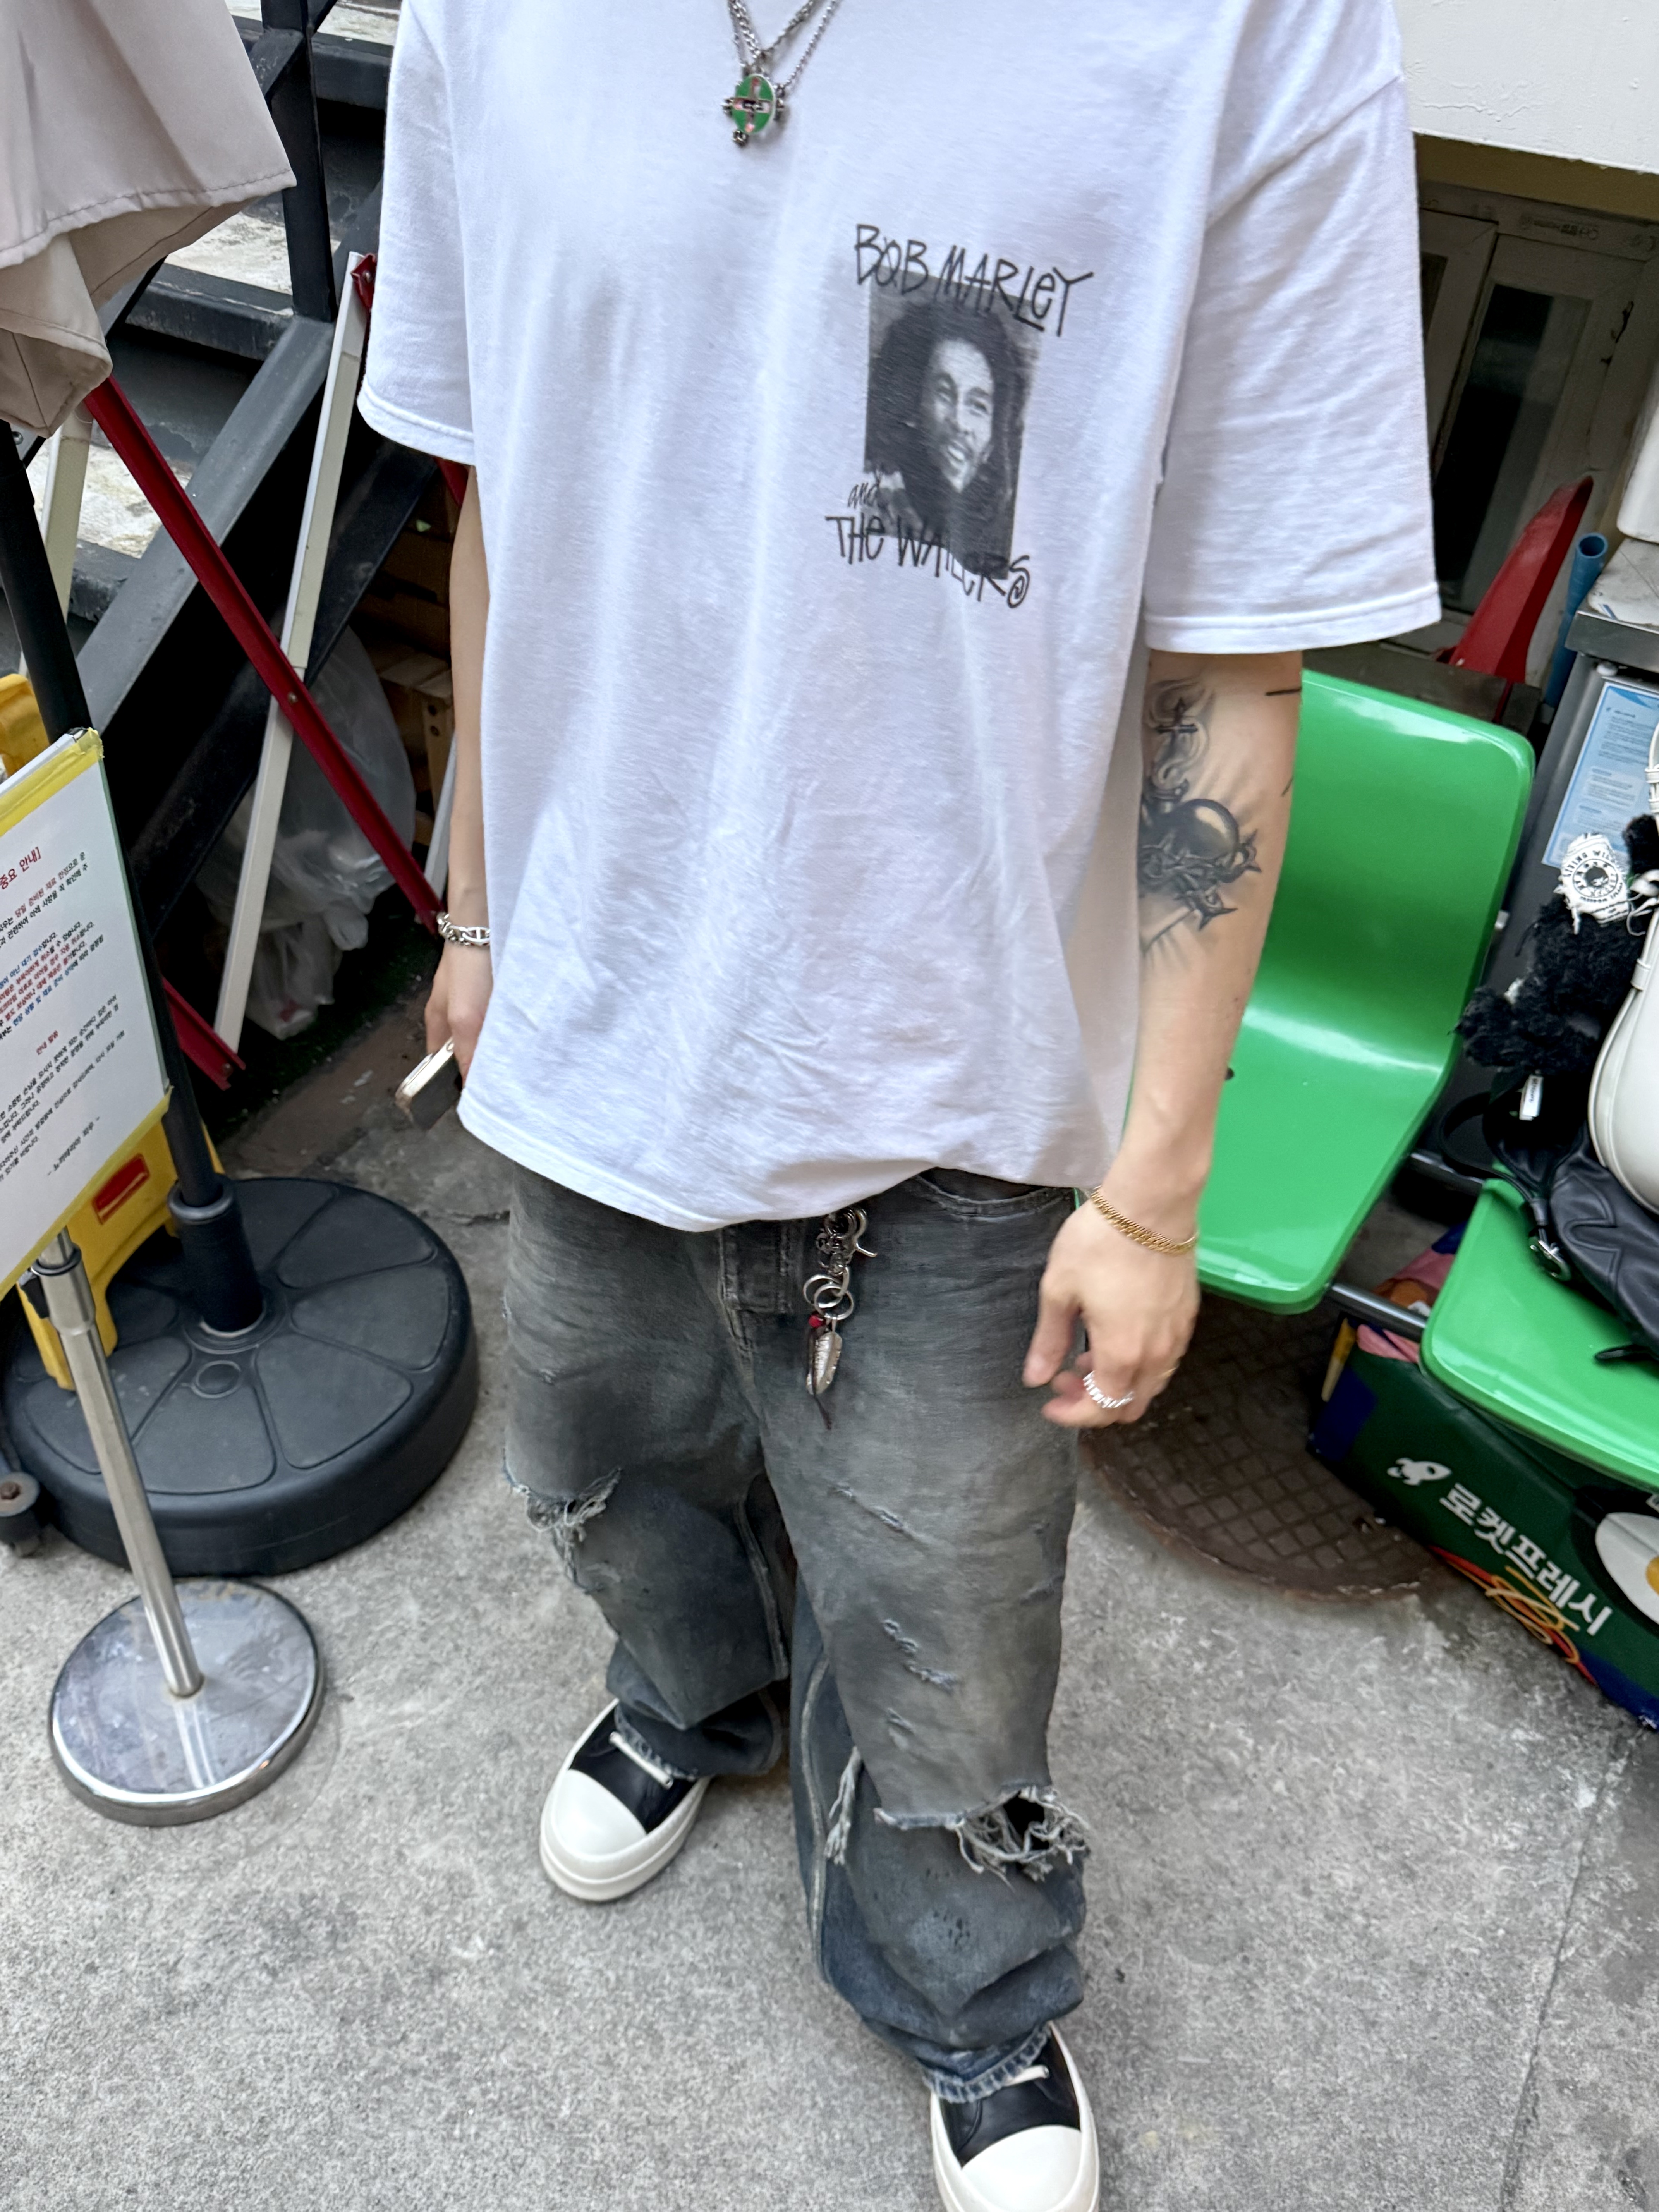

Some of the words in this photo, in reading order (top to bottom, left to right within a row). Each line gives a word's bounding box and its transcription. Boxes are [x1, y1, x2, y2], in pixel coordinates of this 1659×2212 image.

[854, 224, 929, 295] BOB
[19, 847, 41, 872] 안내]
[0, 984, 14, 1003] 이팅은
[1439, 1482, 1613, 1636] 로켓프레시
